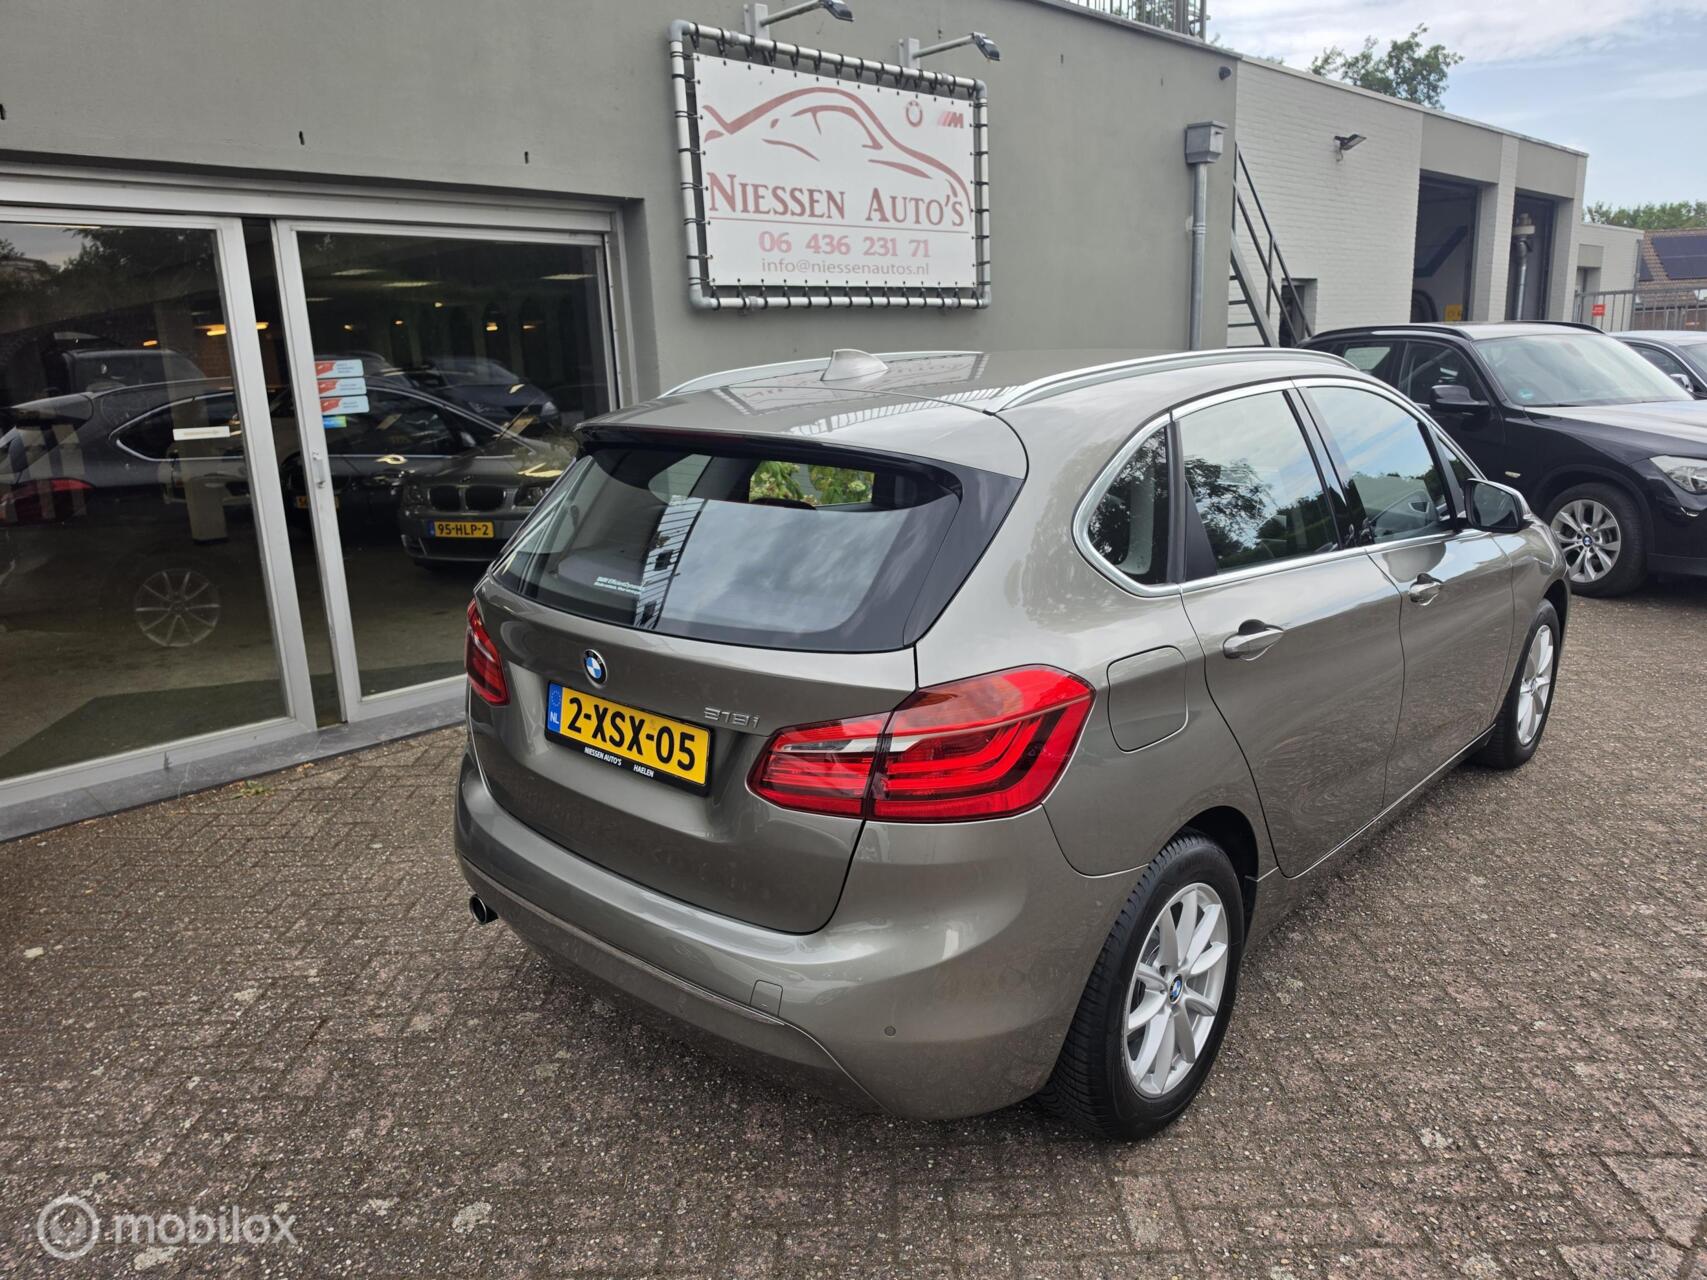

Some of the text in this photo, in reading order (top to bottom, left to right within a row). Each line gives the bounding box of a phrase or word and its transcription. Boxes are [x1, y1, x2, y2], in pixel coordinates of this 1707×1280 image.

[706, 172, 965, 227] NIESSEN AUTO'S
[758, 231, 931, 258] 06 436 231 71
[761, 258, 930, 276] info@niessenautos.nl
[438, 523, 489, 536] 95-HLP-2
[549, 711, 560, 725] NL
[567, 697, 696, 772] 2-XSX-05
[583, 746, 655, 778] NIESSEN AUTO'S HAELEN
